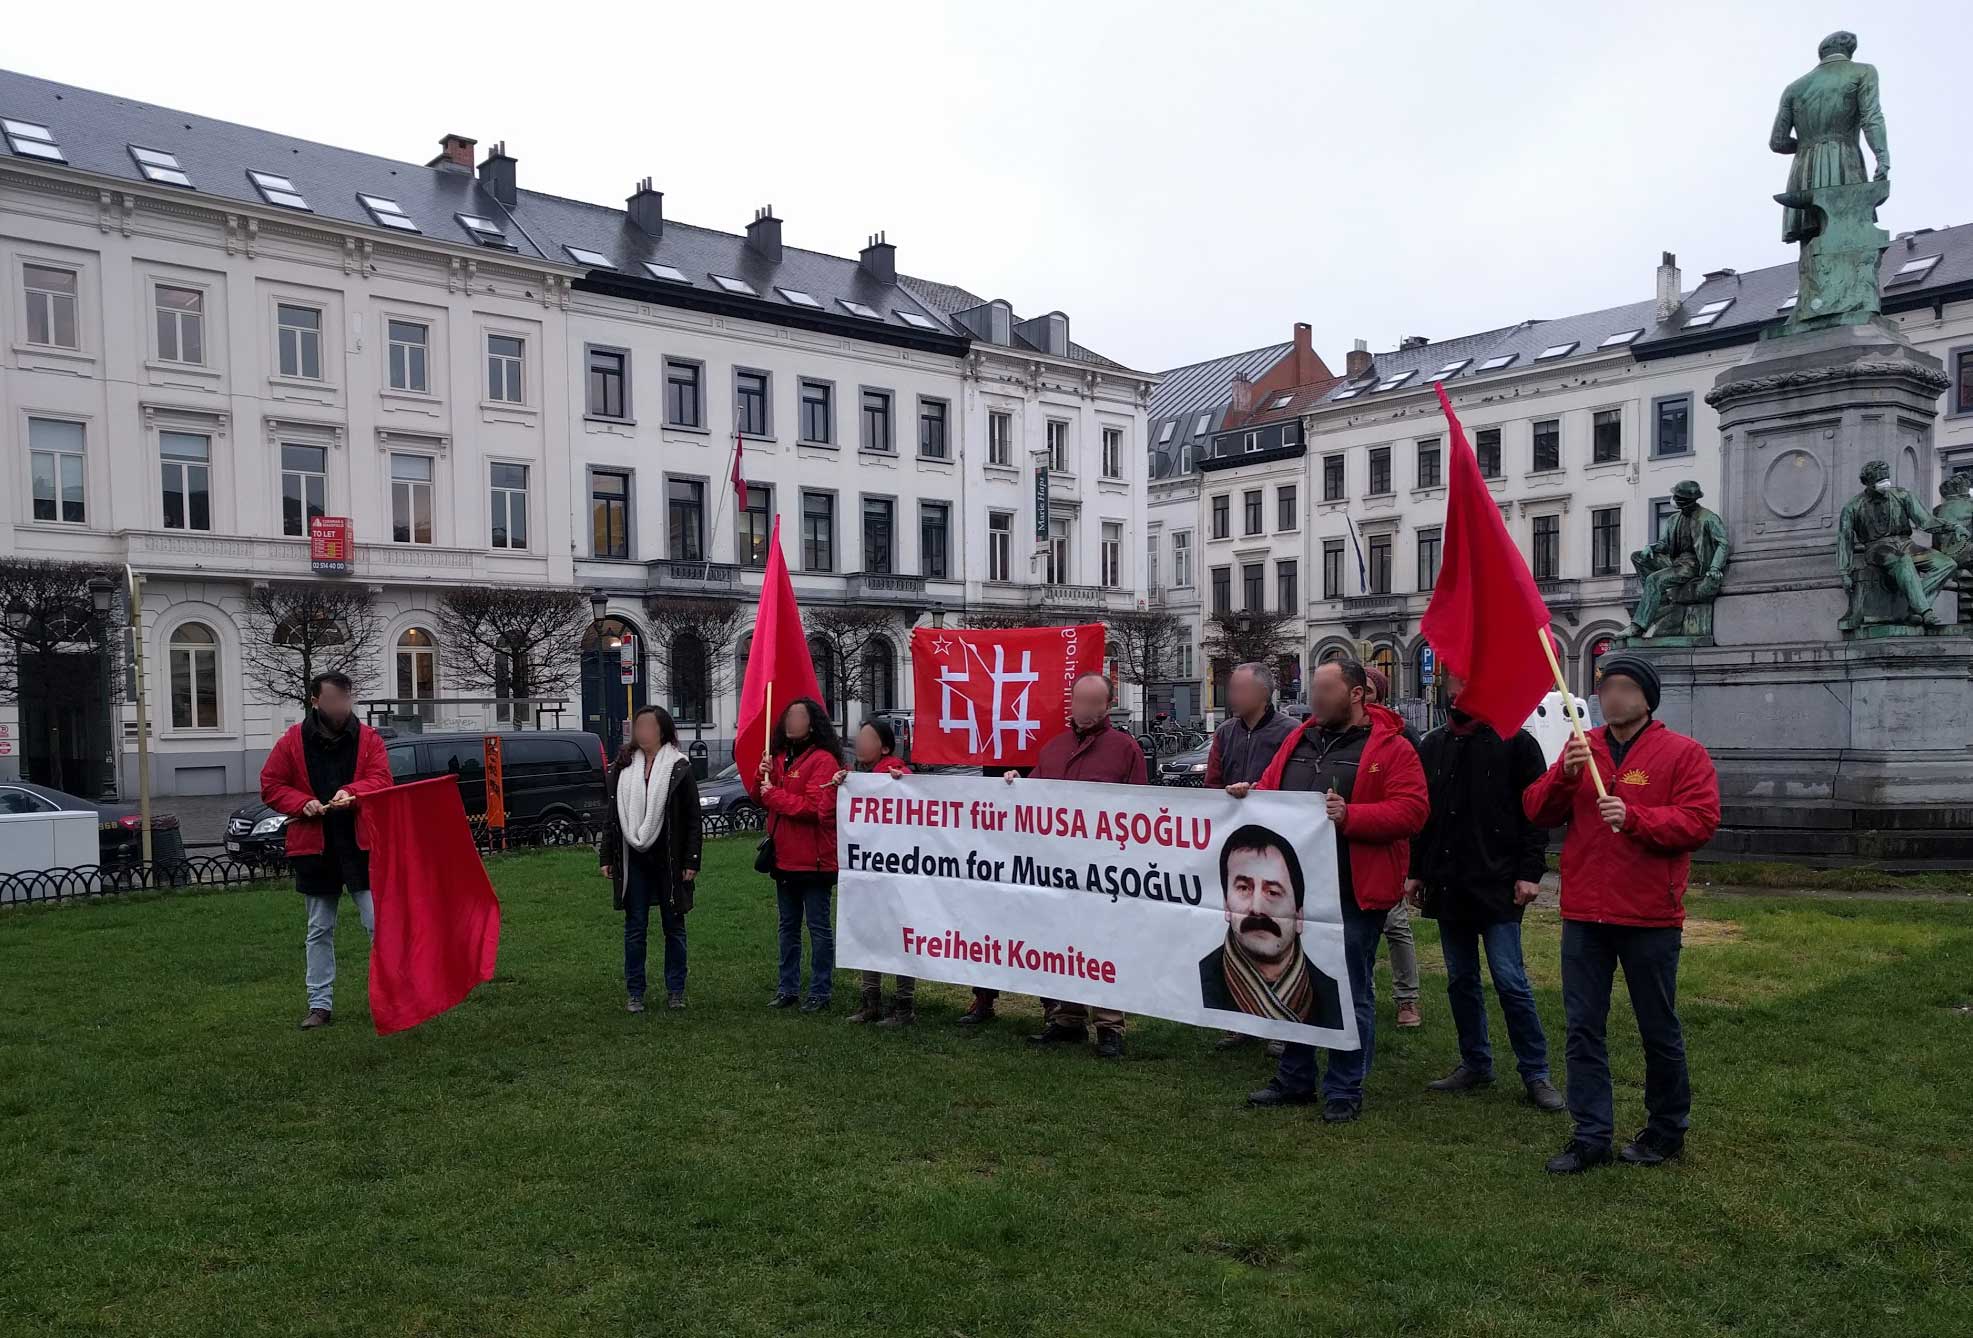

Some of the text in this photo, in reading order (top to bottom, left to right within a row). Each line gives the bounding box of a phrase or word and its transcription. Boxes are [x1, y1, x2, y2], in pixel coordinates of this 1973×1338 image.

[313, 530, 322, 538] TO
[1424, 648, 1432, 663] P
[849, 797, 1212, 850] FREIHEIT für MUSA AŞOĞLU
[847, 843, 1202, 905] Freedom for Musa AŞOĞLU
[902, 927, 1116, 984] Freiheit Komitee
